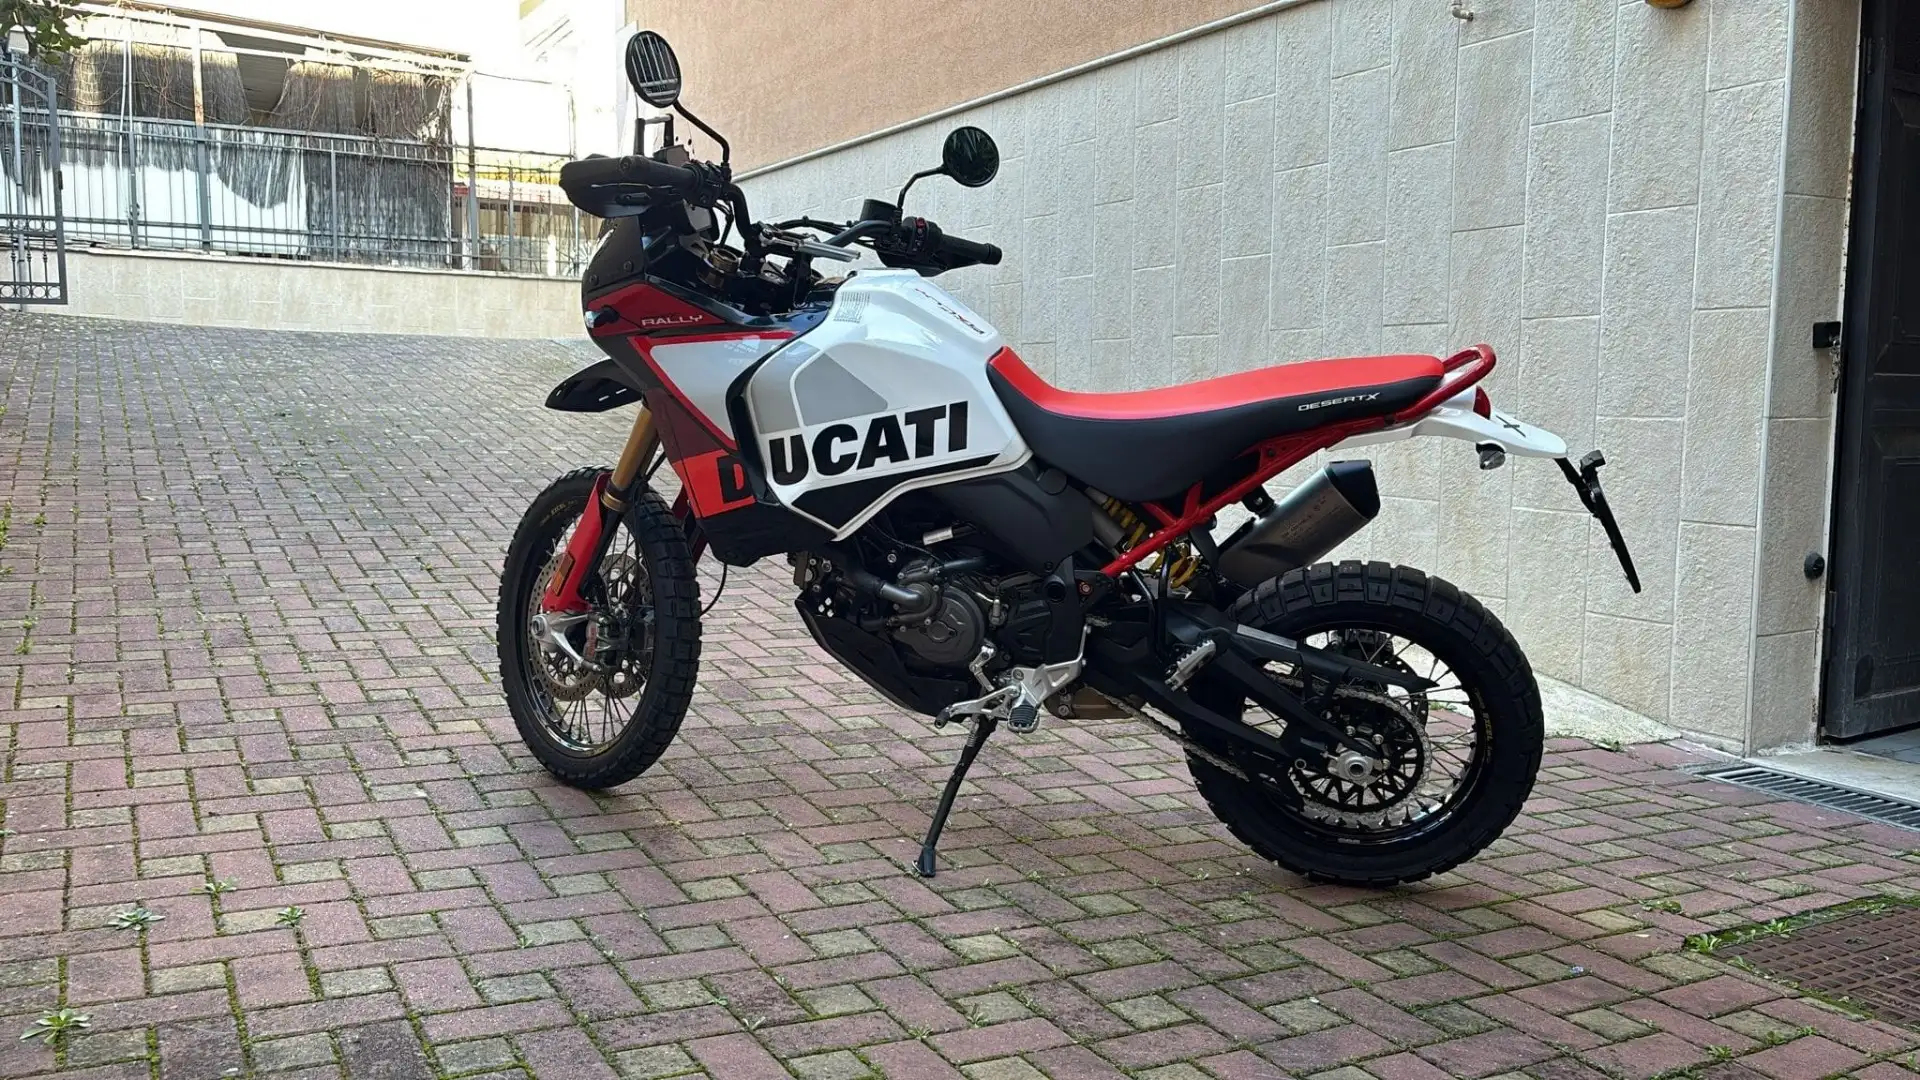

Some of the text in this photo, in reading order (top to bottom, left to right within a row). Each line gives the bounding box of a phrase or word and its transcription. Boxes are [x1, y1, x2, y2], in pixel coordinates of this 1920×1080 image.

[641, 315, 703, 326] RALLY
[1298, 392, 1380, 411] DESERTX
[716, 401, 968, 504] DUCATI
